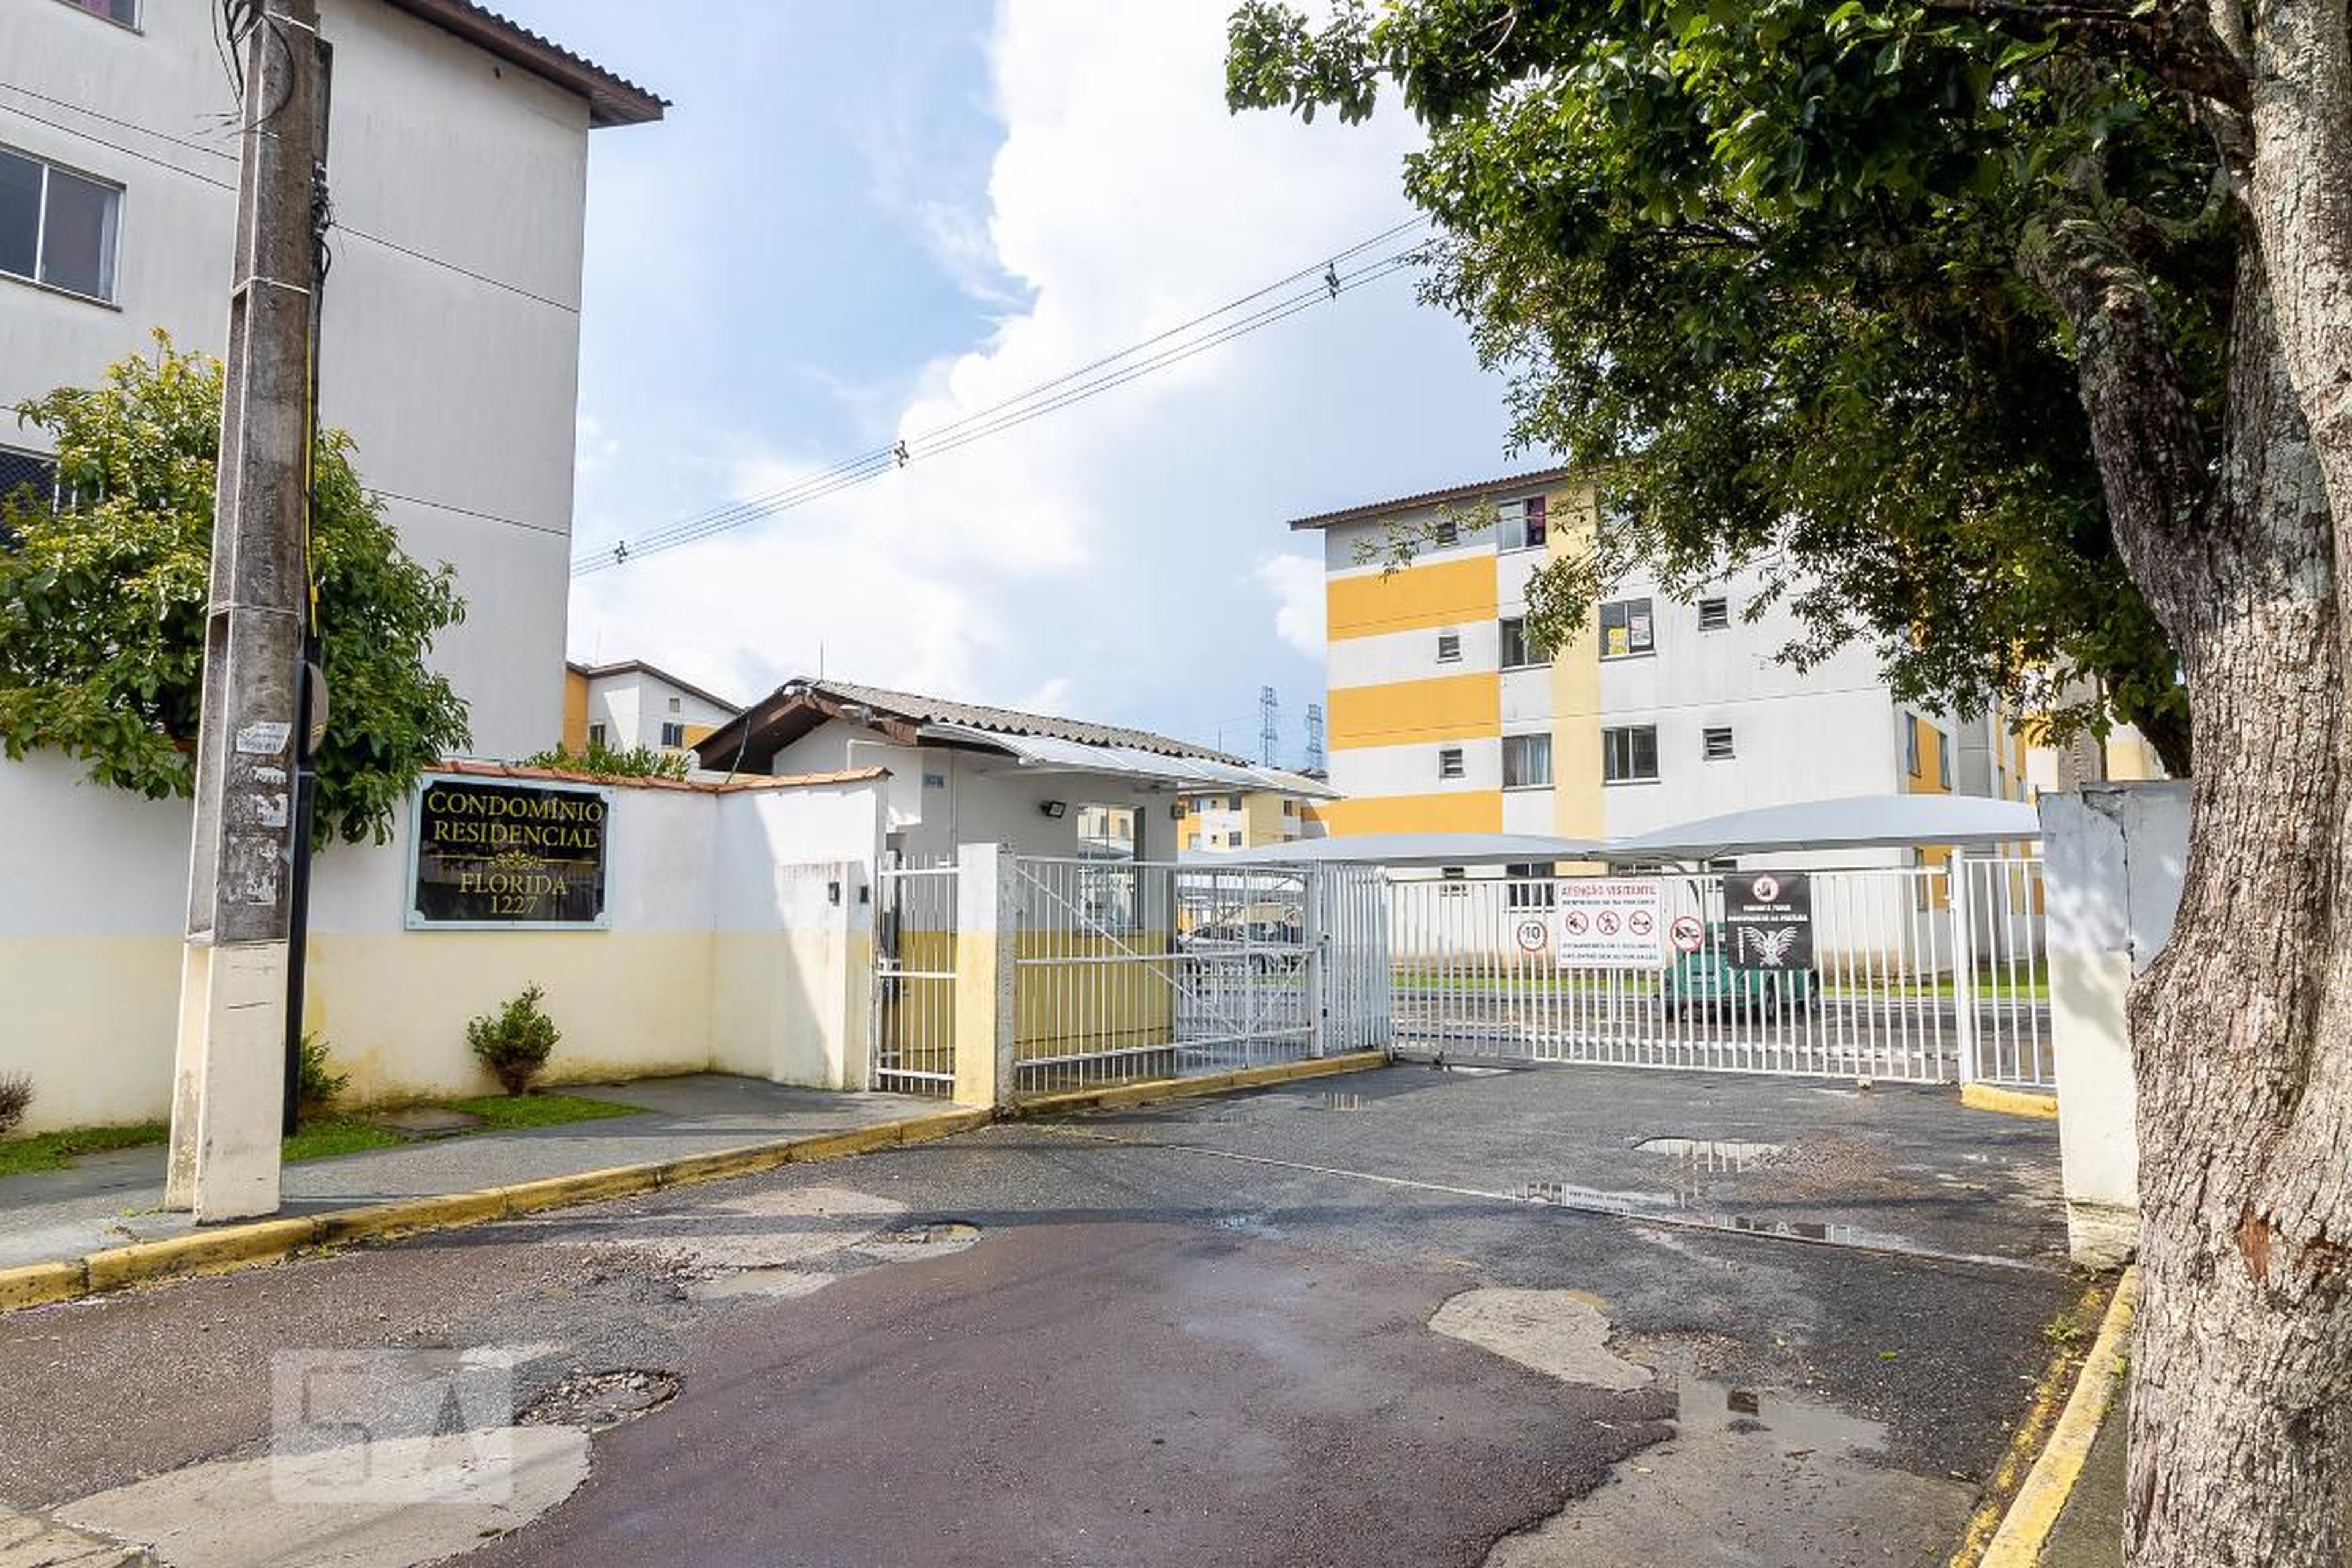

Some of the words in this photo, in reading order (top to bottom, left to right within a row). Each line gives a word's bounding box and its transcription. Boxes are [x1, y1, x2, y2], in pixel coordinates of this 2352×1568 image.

[428, 791, 603, 823] CONDOMÍNIO
[433, 820, 598, 849] RESIDENCIAL
[459, 872, 568, 895] FLORIDA
[491, 895, 538, 914] 1227
